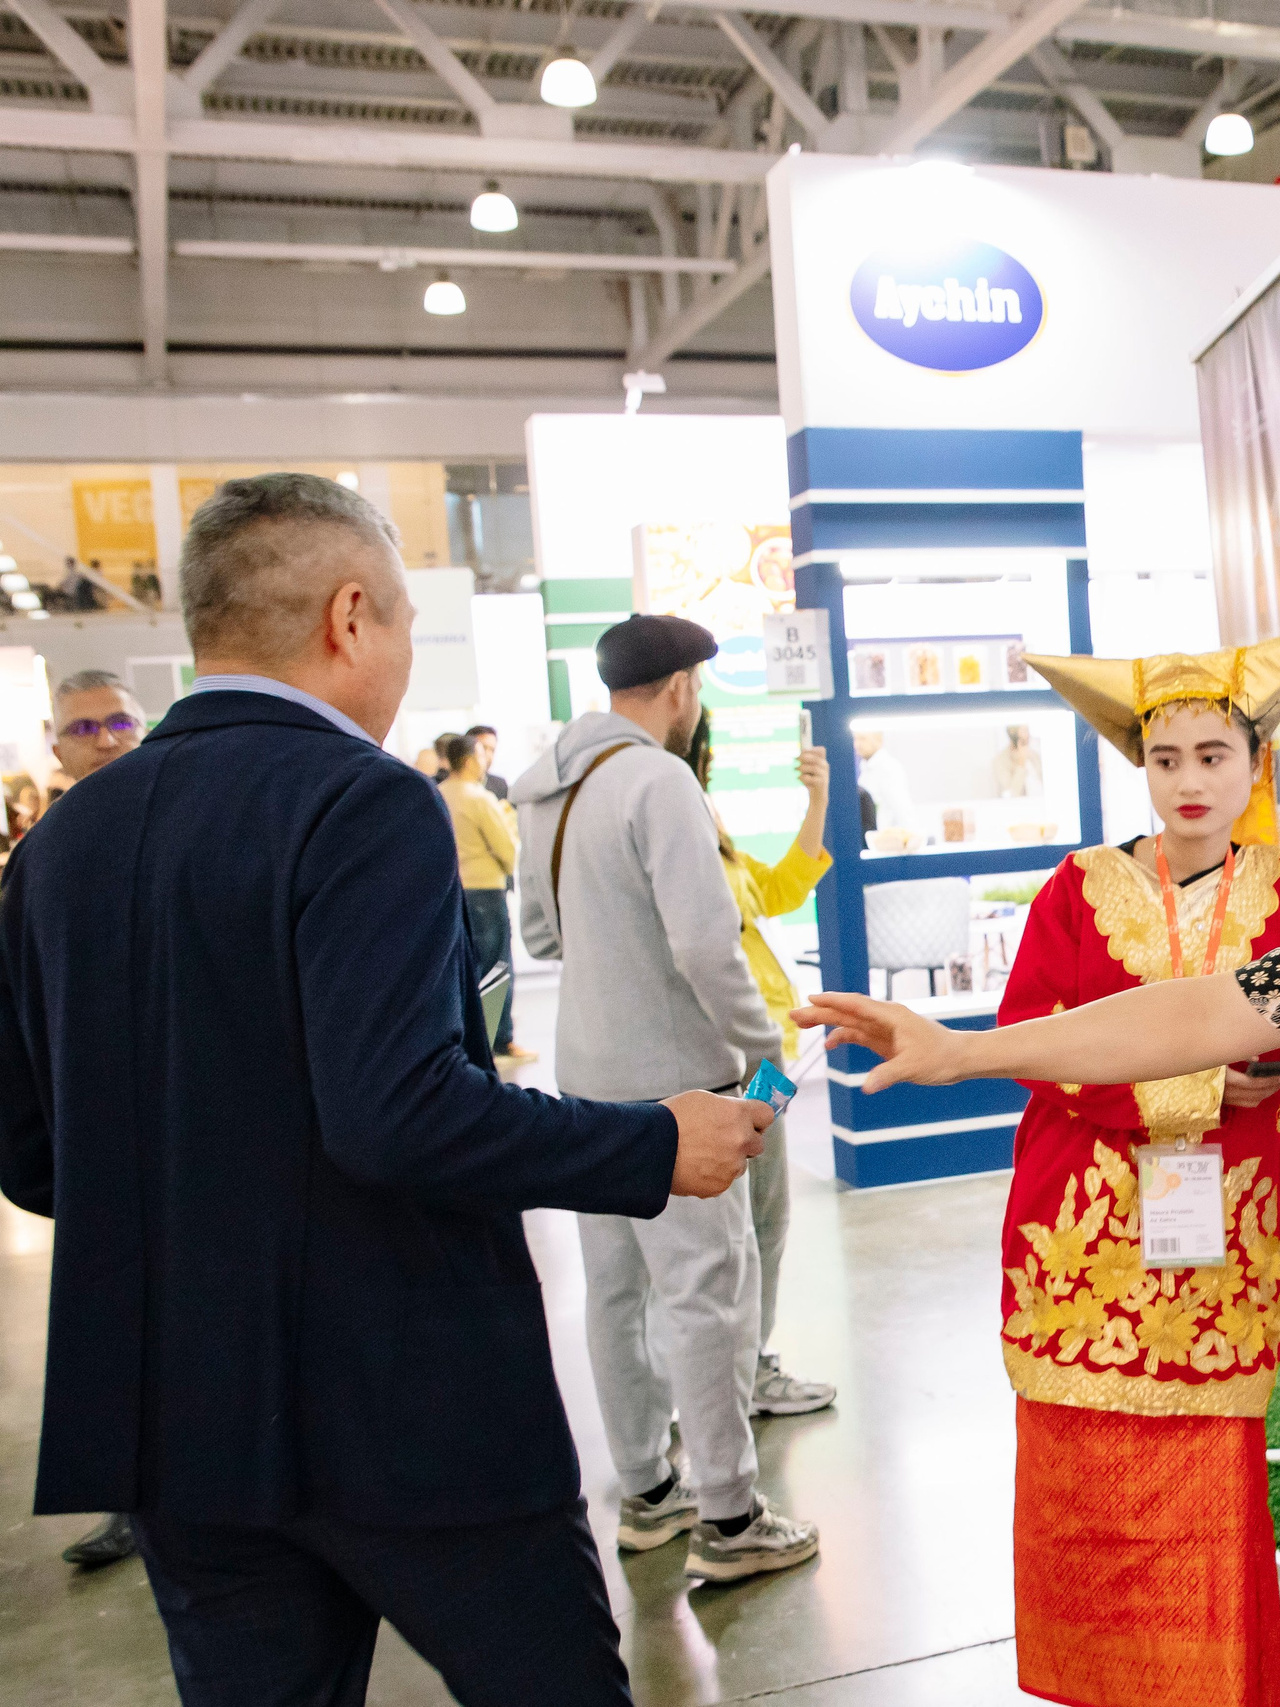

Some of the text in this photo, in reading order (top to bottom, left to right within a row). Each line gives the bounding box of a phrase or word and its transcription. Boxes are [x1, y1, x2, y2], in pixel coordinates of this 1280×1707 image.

[874, 275, 1023, 327] Aychin
[786, 627, 799, 642] B
[773, 645, 816, 662] 3045
